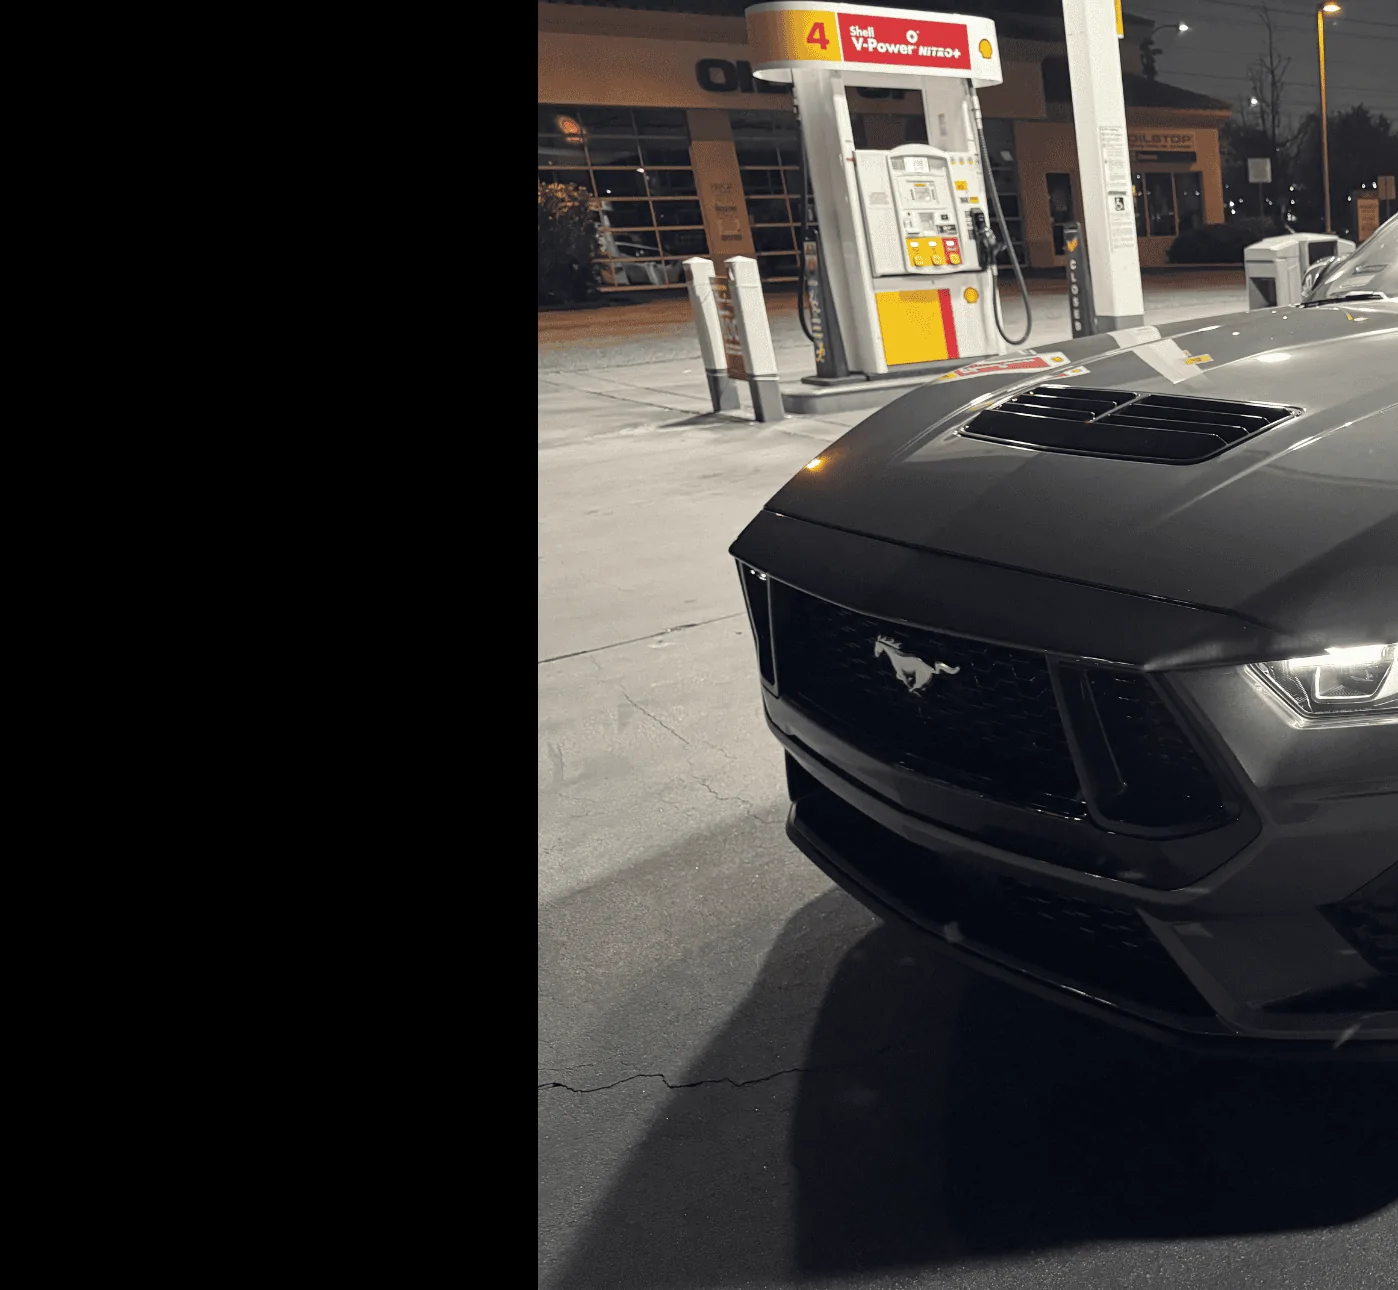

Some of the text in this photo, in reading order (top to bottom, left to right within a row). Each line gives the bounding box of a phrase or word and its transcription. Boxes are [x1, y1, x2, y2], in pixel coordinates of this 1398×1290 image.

[806, 22, 830, 50] 4
[849, 25, 875, 38] Shell
[851, 36, 961, 59] V-Power NITRO+
[1069, 259, 1082, 331] CLOSED
